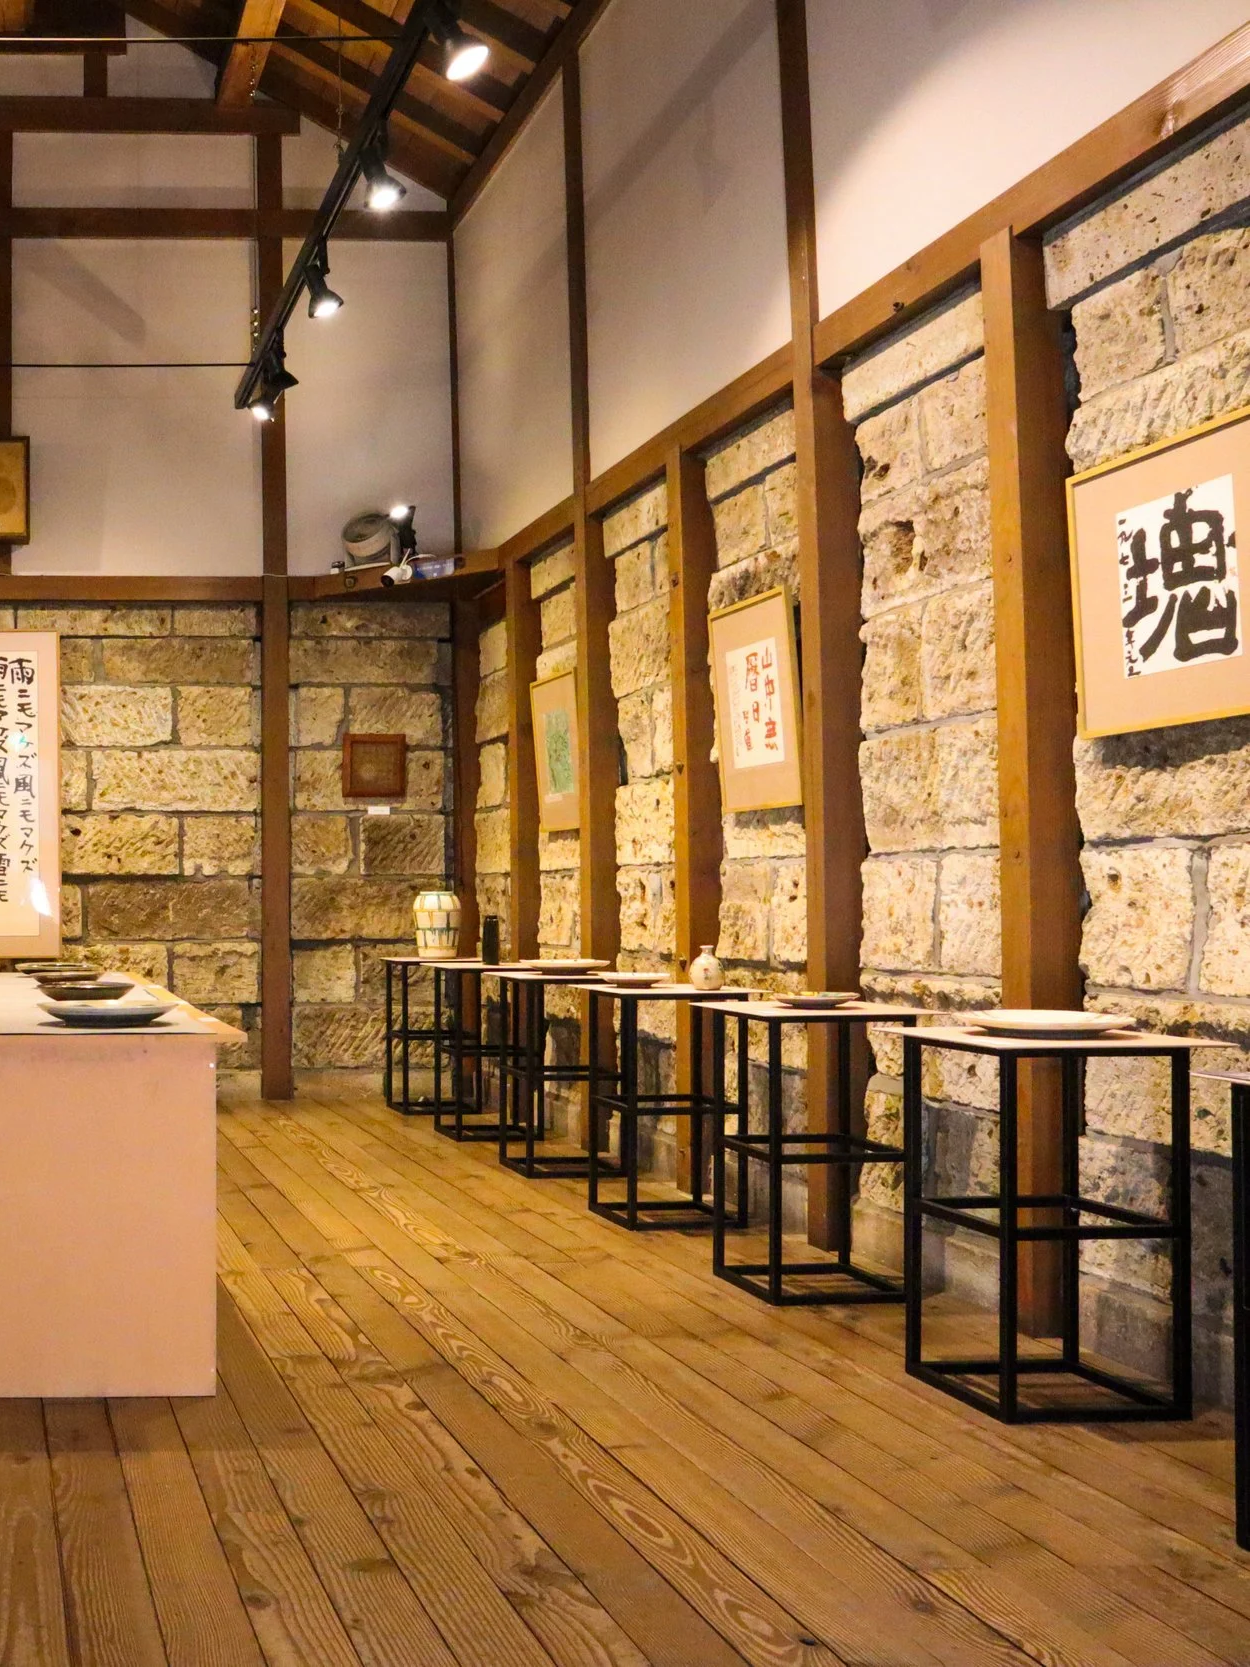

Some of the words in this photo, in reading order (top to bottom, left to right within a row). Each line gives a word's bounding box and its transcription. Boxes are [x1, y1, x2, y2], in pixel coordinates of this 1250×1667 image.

[9, 657, 38, 873] 雨ニモマケズ風ニモマケズ
